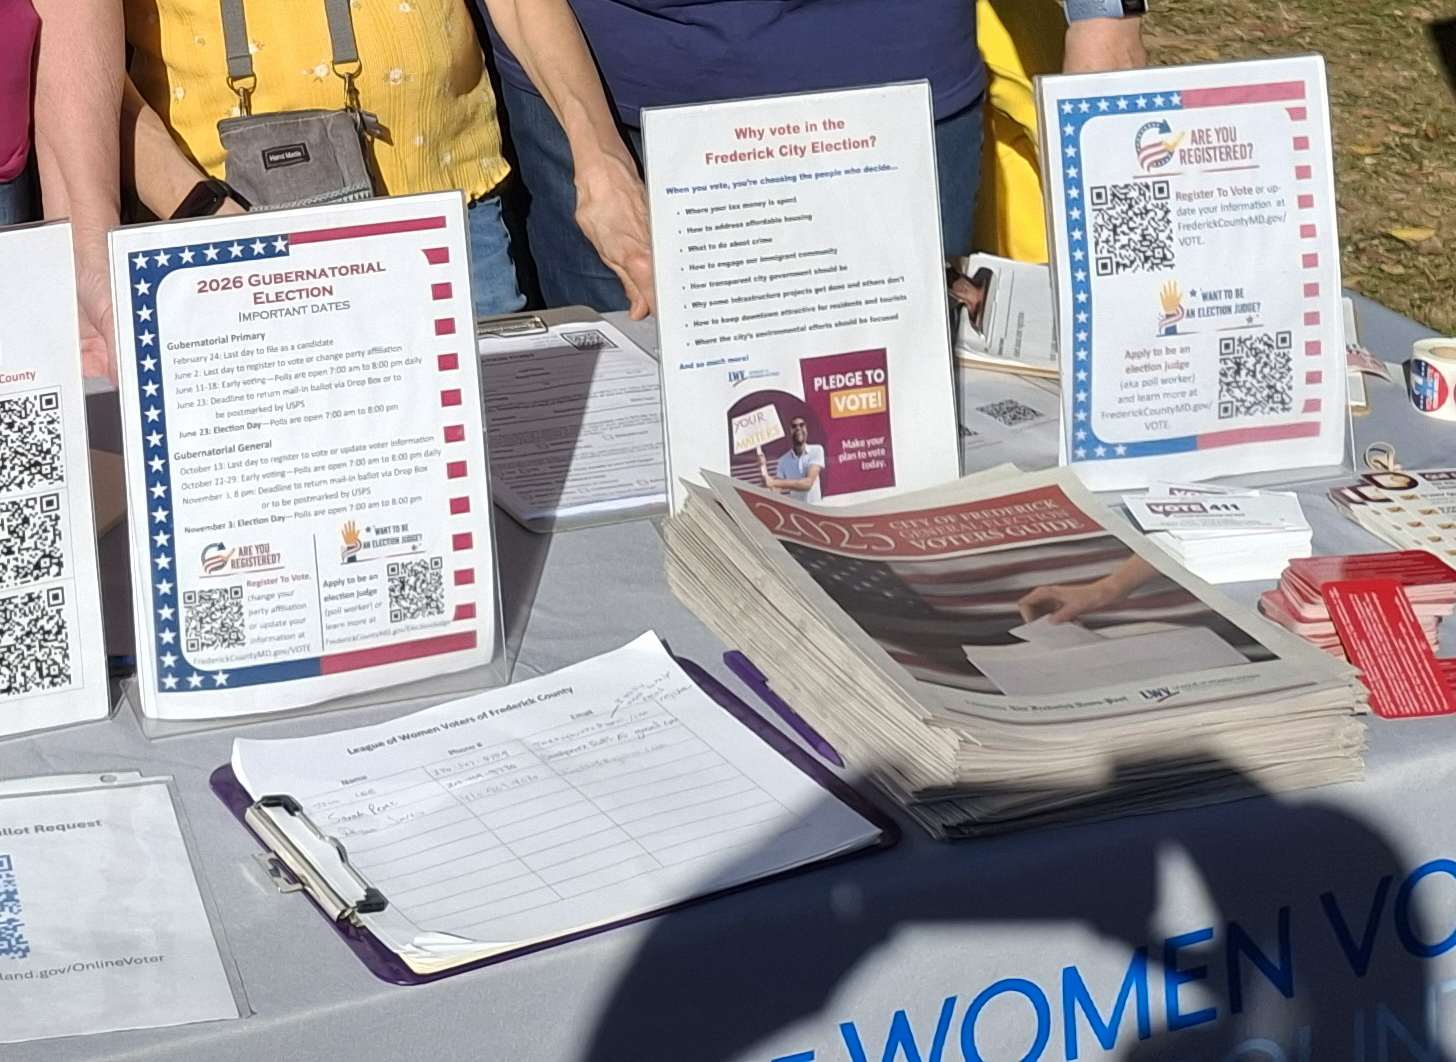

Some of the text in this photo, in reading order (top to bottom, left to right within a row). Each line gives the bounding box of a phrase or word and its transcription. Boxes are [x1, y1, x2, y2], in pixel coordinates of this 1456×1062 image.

[734, 118, 844, 139] Why vote in the
[1190, 126, 1236, 145] ARE YOU
[705, 135, 876, 164] Frederick City Election?
[1178, 143, 1253, 164] REGISTERED?
[1175, 189, 1214, 202] Register
[1216, 187, 1228, 197] To
[1229, 186, 1253, 196] Vote
[1255, 186, 1263, 194] or
[197, 261, 386, 293] 2026 GUBERNATORIAL
[252, 285, 333, 304] ELECTION
[1201, 287, 1243, 301] WANT TO BE
[238, 300, 350, 321] IMPORTANT DATES
[1185, 301, 1260, 318] AN ELECTION JUDGE?
[166, 332, 265, 350] Gubernatorial Primary
[813, 368, 884, 392] PLEDGE TO
[834, 392, 881, 412] VOTE!
[734, 412, 766, 434] YOUR
[173, 439, 272, 460] Gubernatorial General
[841, 436, 884, 449] Make your
[837, 448, 886, 463] plan to vote
[1150, 504, 1203, 513] VOTE
[755, 502, 896, 551] 2025
[888, 516, 930, 530] CITY
[908, 518, 1085, 551] VOTERS GUIDE
[346, 686, 574, 755] League of Women Voters of Frederick County
[33, 819, 102, 833] Request
[839, 906, 1295, 1062] WOMEN
